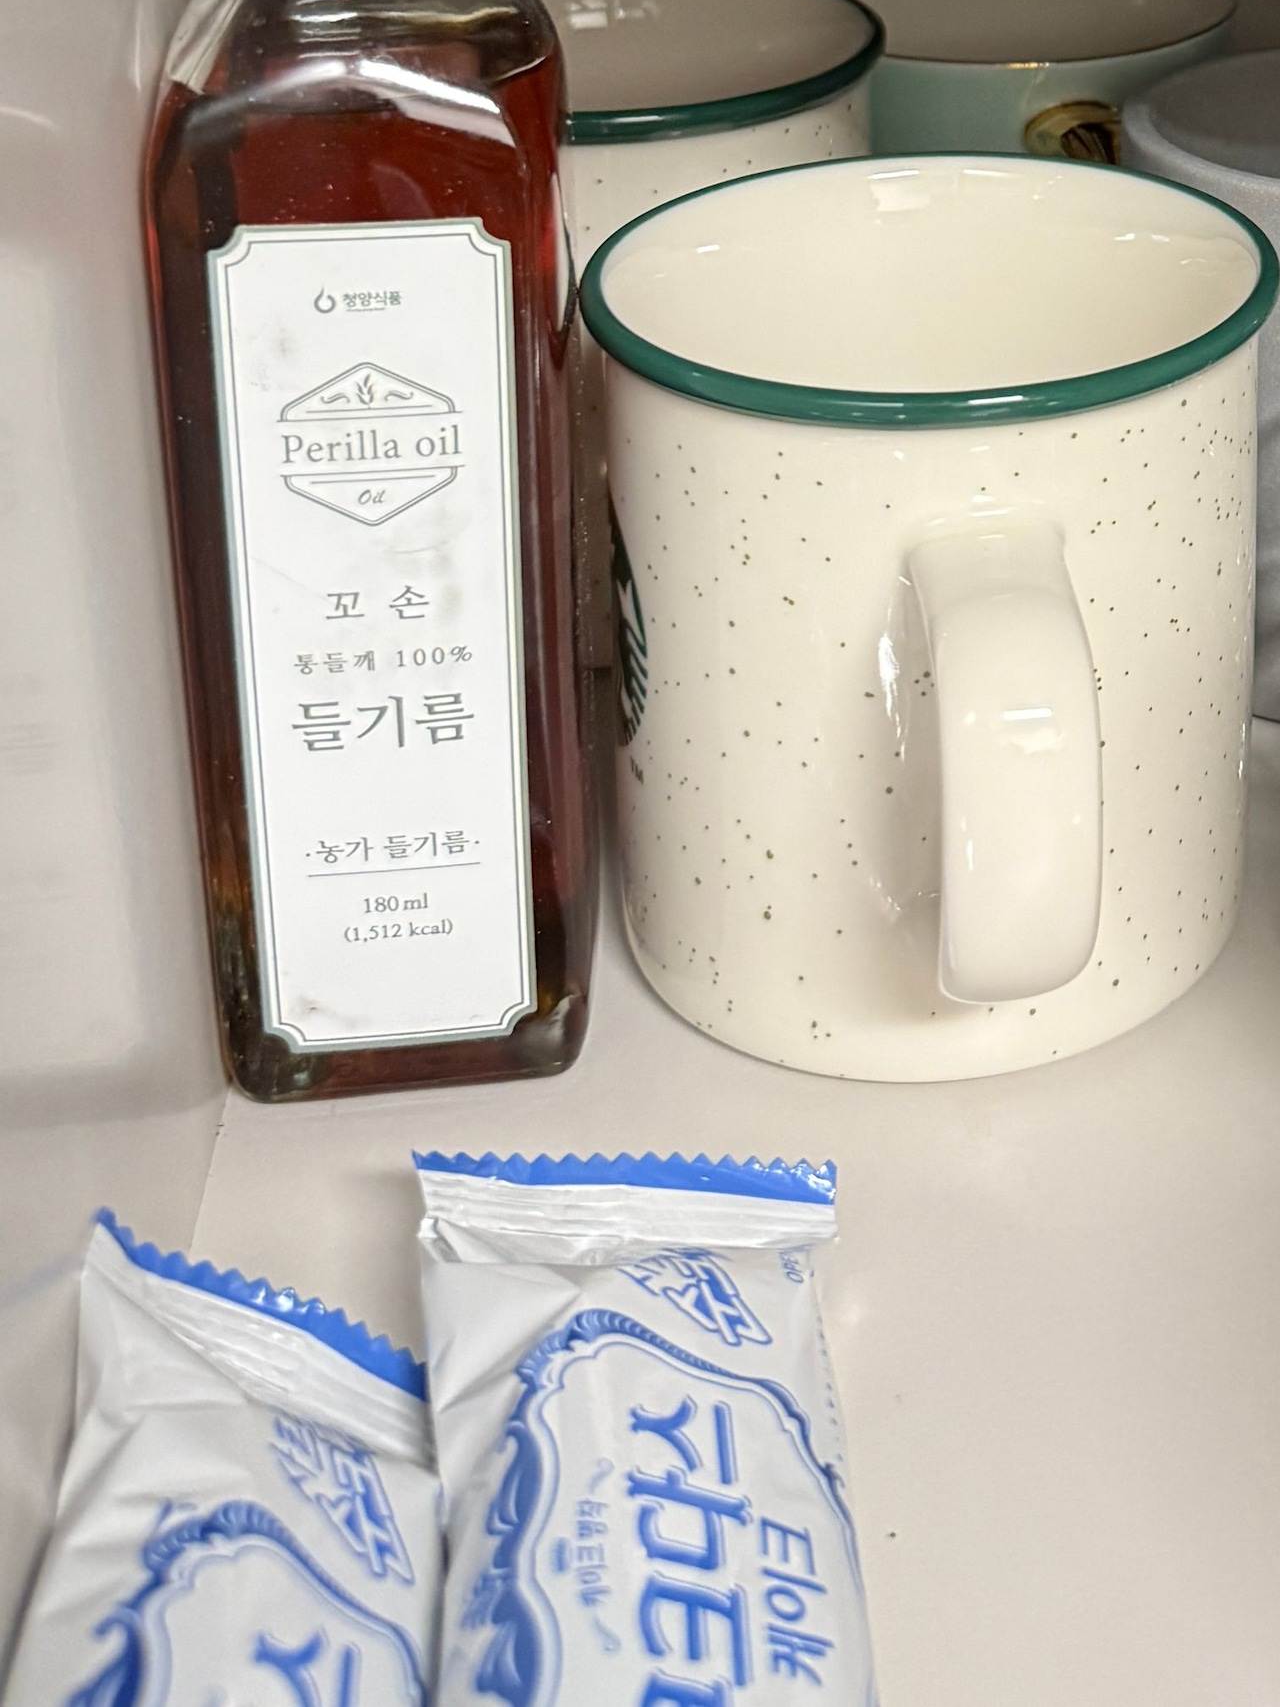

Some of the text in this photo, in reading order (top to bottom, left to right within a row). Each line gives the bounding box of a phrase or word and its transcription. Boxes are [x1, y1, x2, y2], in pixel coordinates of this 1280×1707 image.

[281, 424, 463, 465] Perilla oil
[294, 645, 473, 675] 통들깨 100%
[292, 692, 475, 752] 들기름
[409, 918, 454, 938] kcal)
[758, 1516, 837, 1686] 케이크
